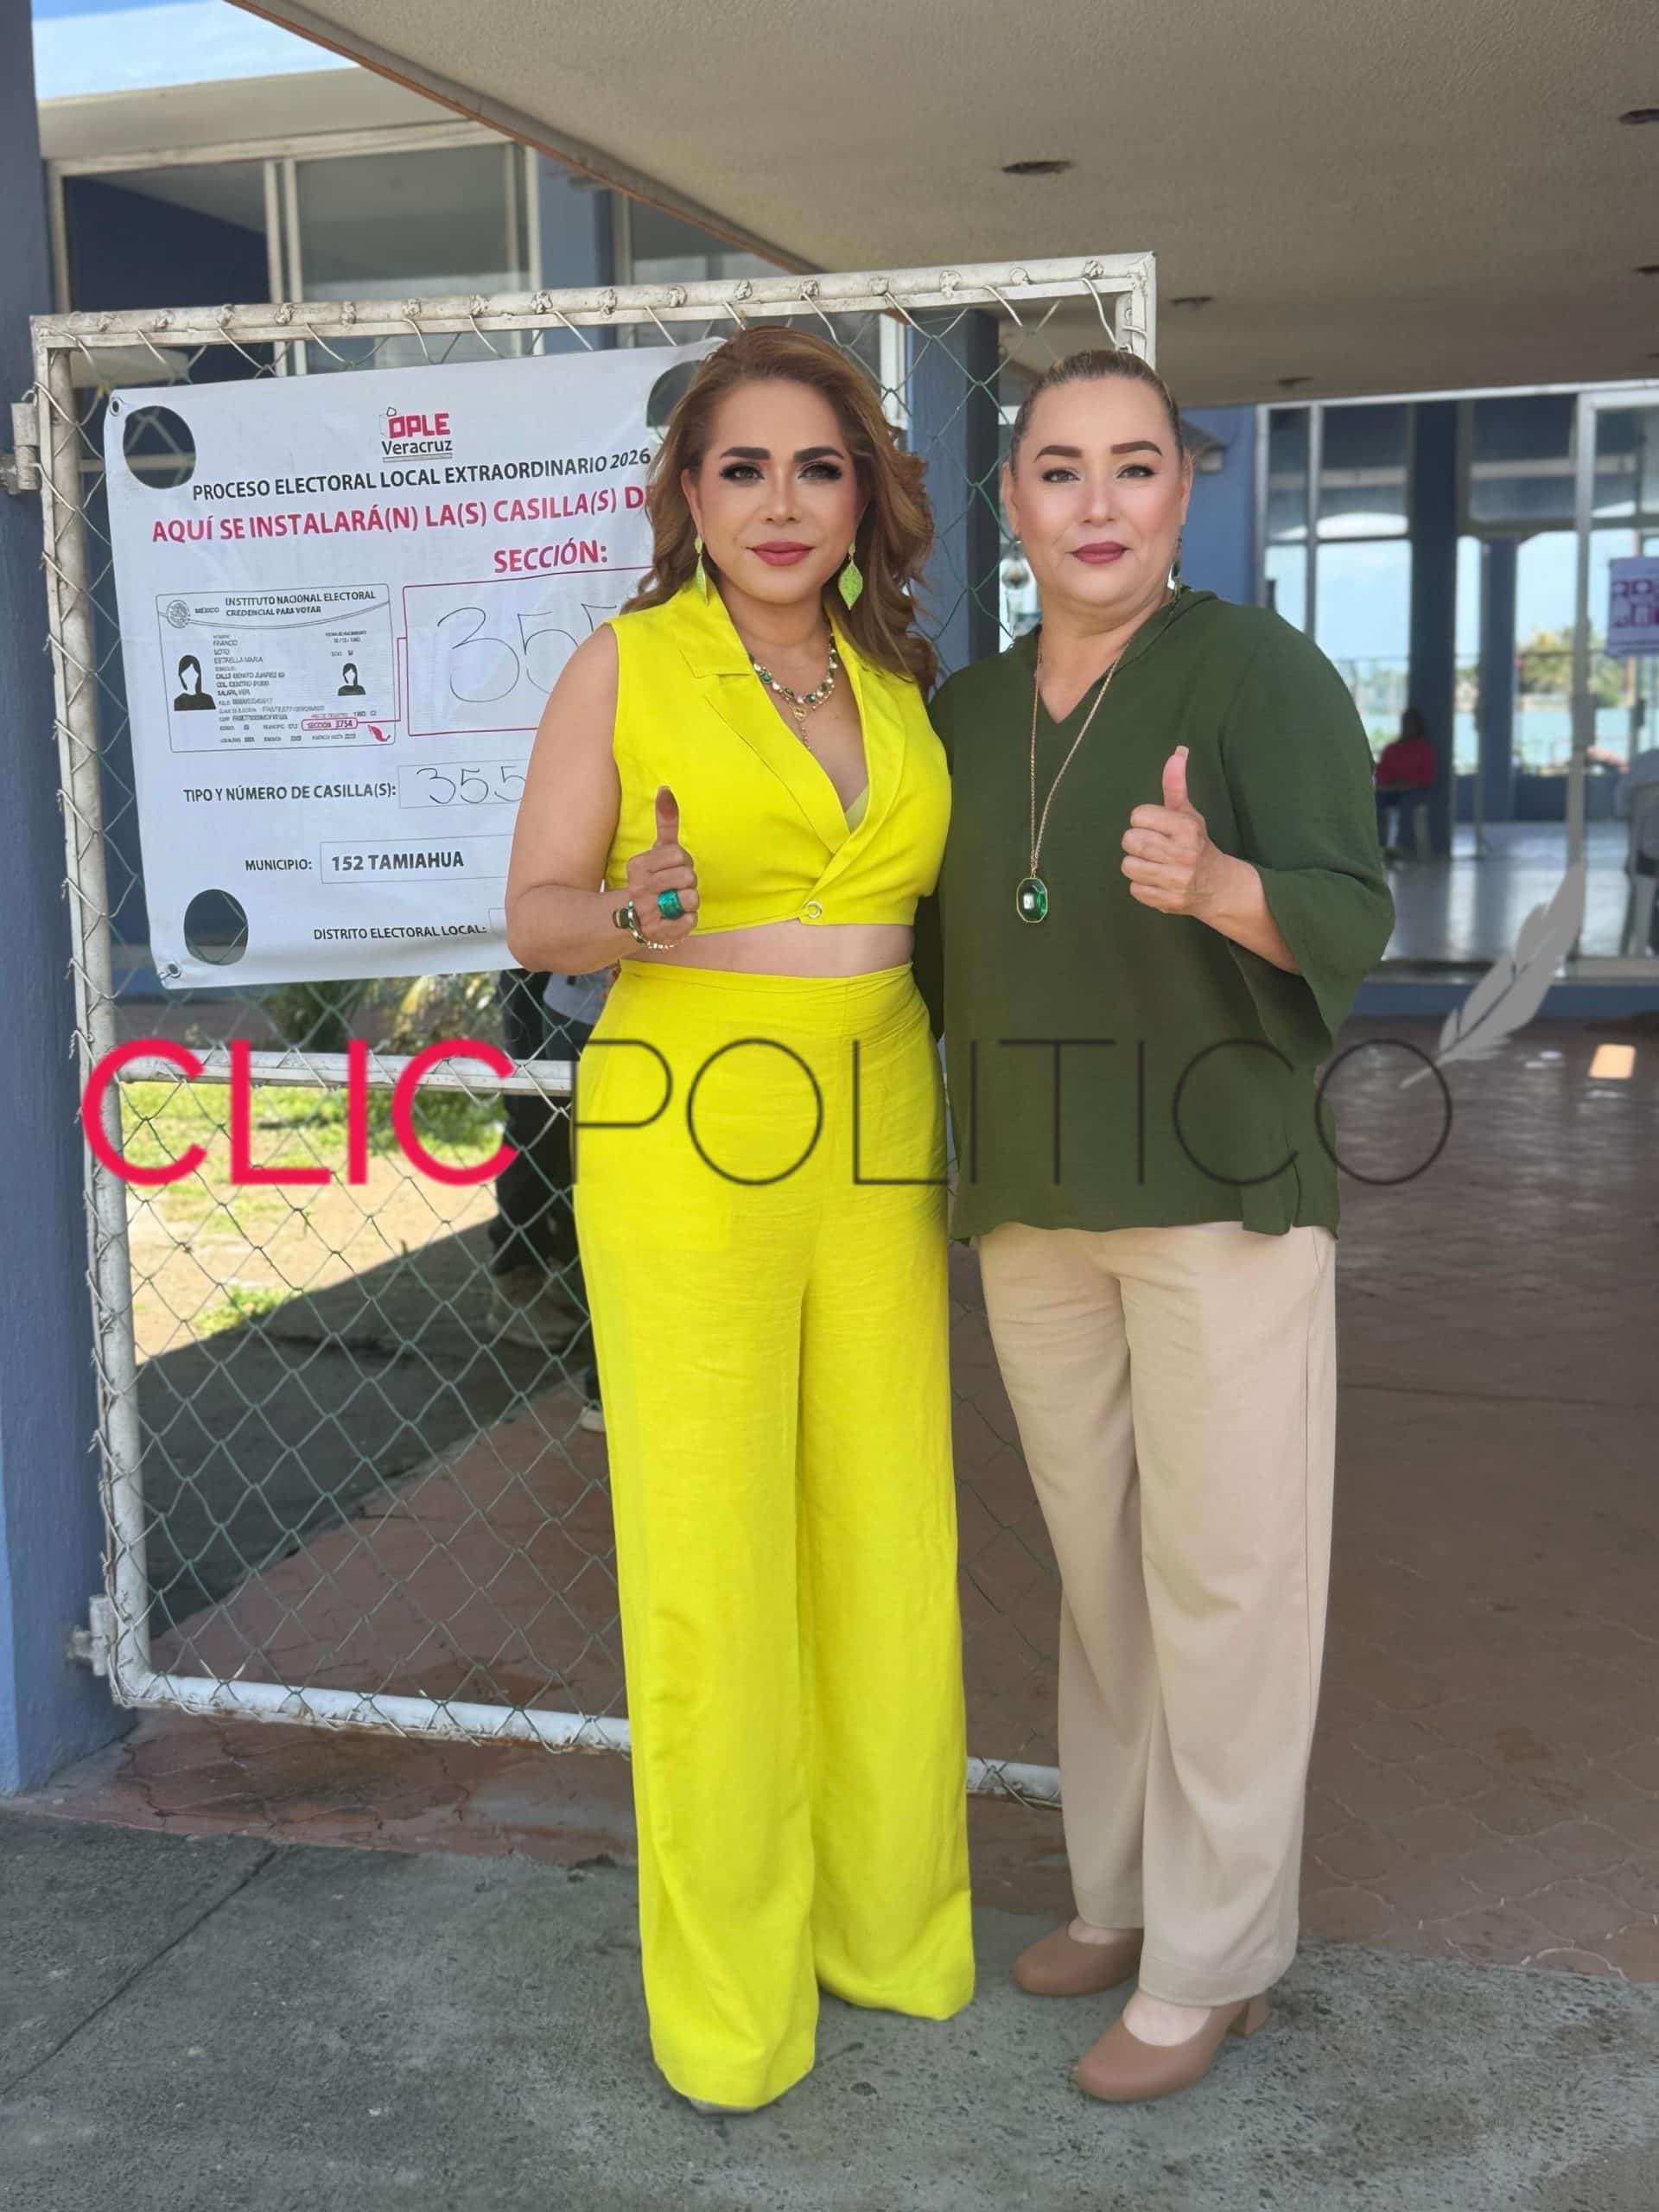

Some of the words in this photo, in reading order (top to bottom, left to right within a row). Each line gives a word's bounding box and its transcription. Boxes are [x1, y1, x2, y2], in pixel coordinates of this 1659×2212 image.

[389, 413, 450, 438] OPLE
[382, 440, 452, 455] Veracruz
[193, 480, 270, 500] PROCESO
[275, 473, 377, 495] ELECTORAL
[380, 467, 441, 488] LOCAL
[445, 455, 607, 483] EXTRAORDINARIO
[609, 448, 651, 469] 2026
[152, 515, 213, 543] AQUÍ
[220, 518, 245, 540] SE
[249, 504, 417, 538] INSTALARÁ(N)
[425, 501, 486, 527] LA(S)
[493, 488, 617, 522] CASILLA(S)
[625, 486, 650, 509] D
[493, 537, 607, 573] SECCIÓN:
[226, 596, 275, 607] INSTITUTO
[276, 594, 321, 605] NACIONAL
[323, 591, 376, 602] ELECTORAL
[183, 787, 213, 802] TIPO
[215, 787, 223, 801] Y
[226, 785, 287, 800] NÚMERO
[291, 785, 310, 798] DE
[314, 782, 397, 798] CASILLA(S):
[245, 858, 312, 872] MUNICIPIO:
[332, 855, 364, 871] 152
[367, 851, 464, 870] TAMIAHUA
[314, 928, 367, 939] DISTRITO
[371, 925, 440, 938] ELECTORAL
[441, 924, 487, 936] LOCAL:
